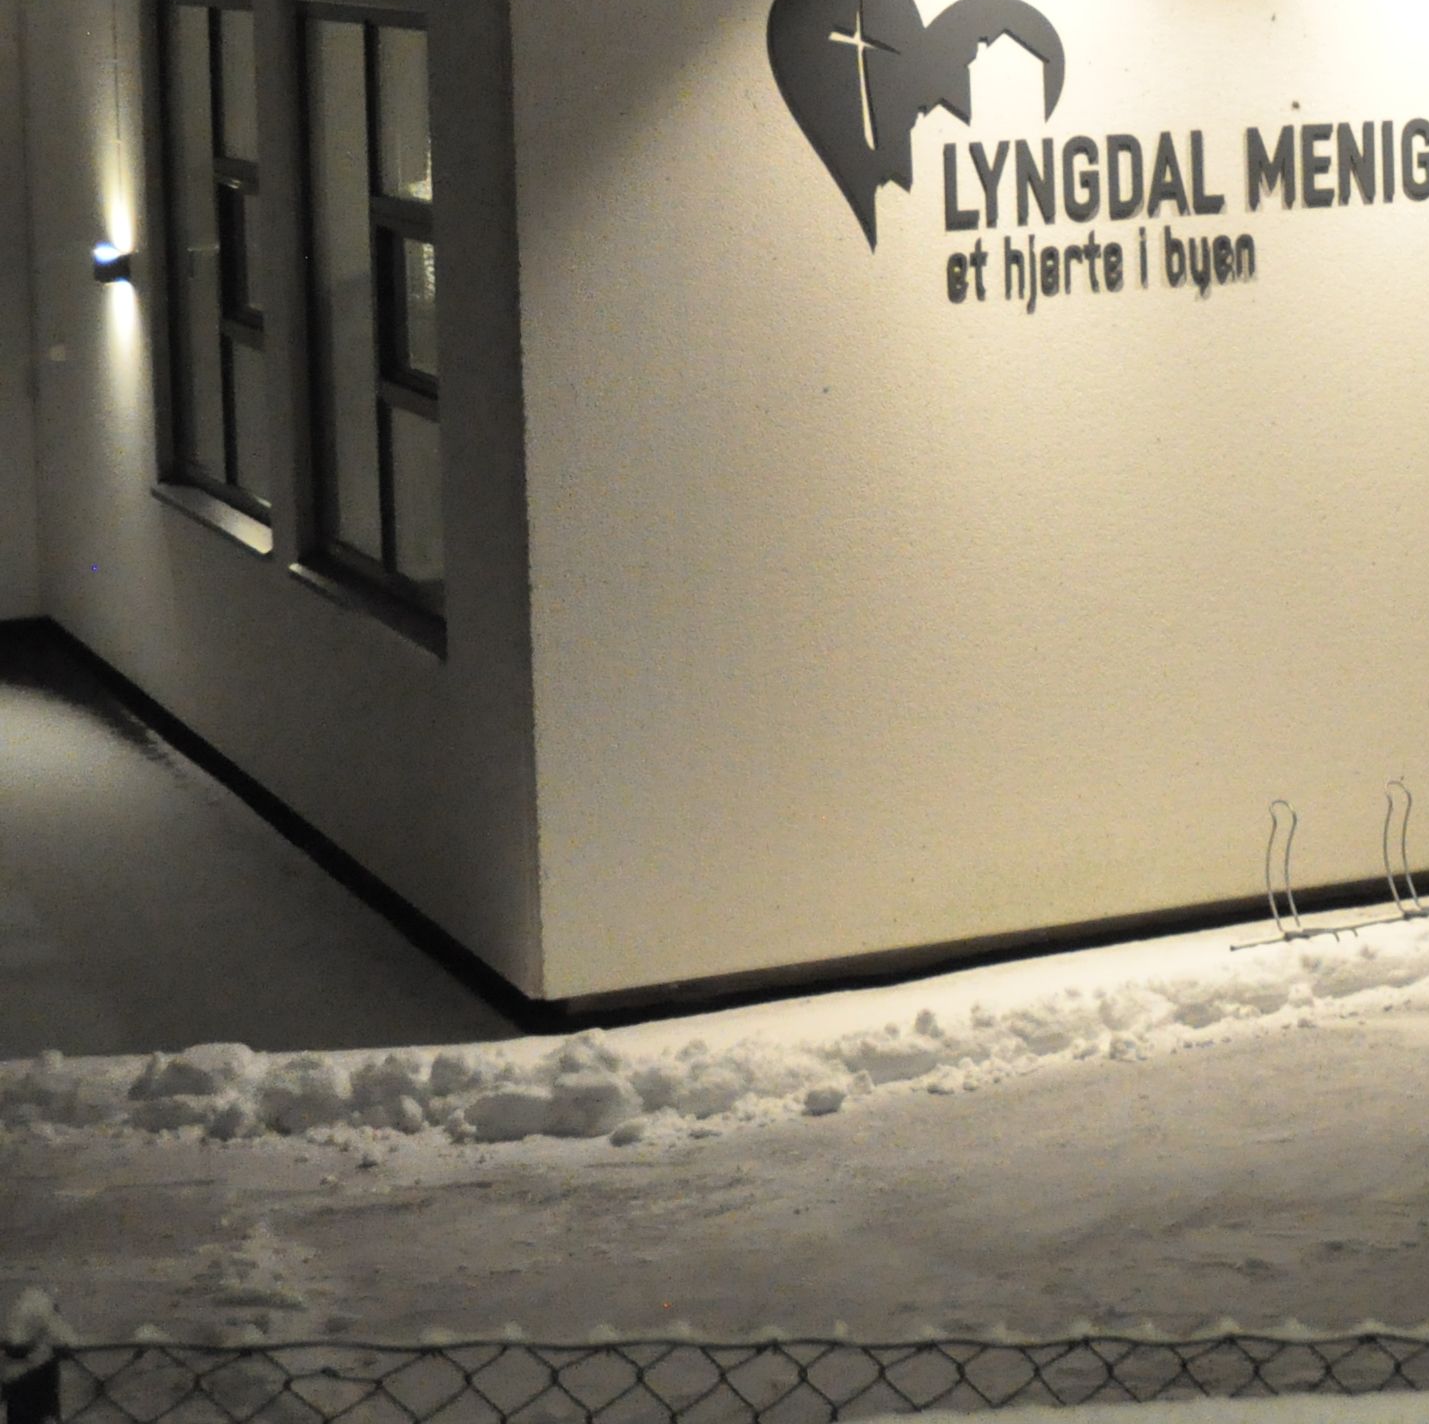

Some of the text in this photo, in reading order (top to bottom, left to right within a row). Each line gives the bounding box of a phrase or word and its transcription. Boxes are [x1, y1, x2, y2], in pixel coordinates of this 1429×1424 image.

[943, 130, 1225, 231] LYNGDAL
[946, 225, 1257, 314] et hjerte i byen
